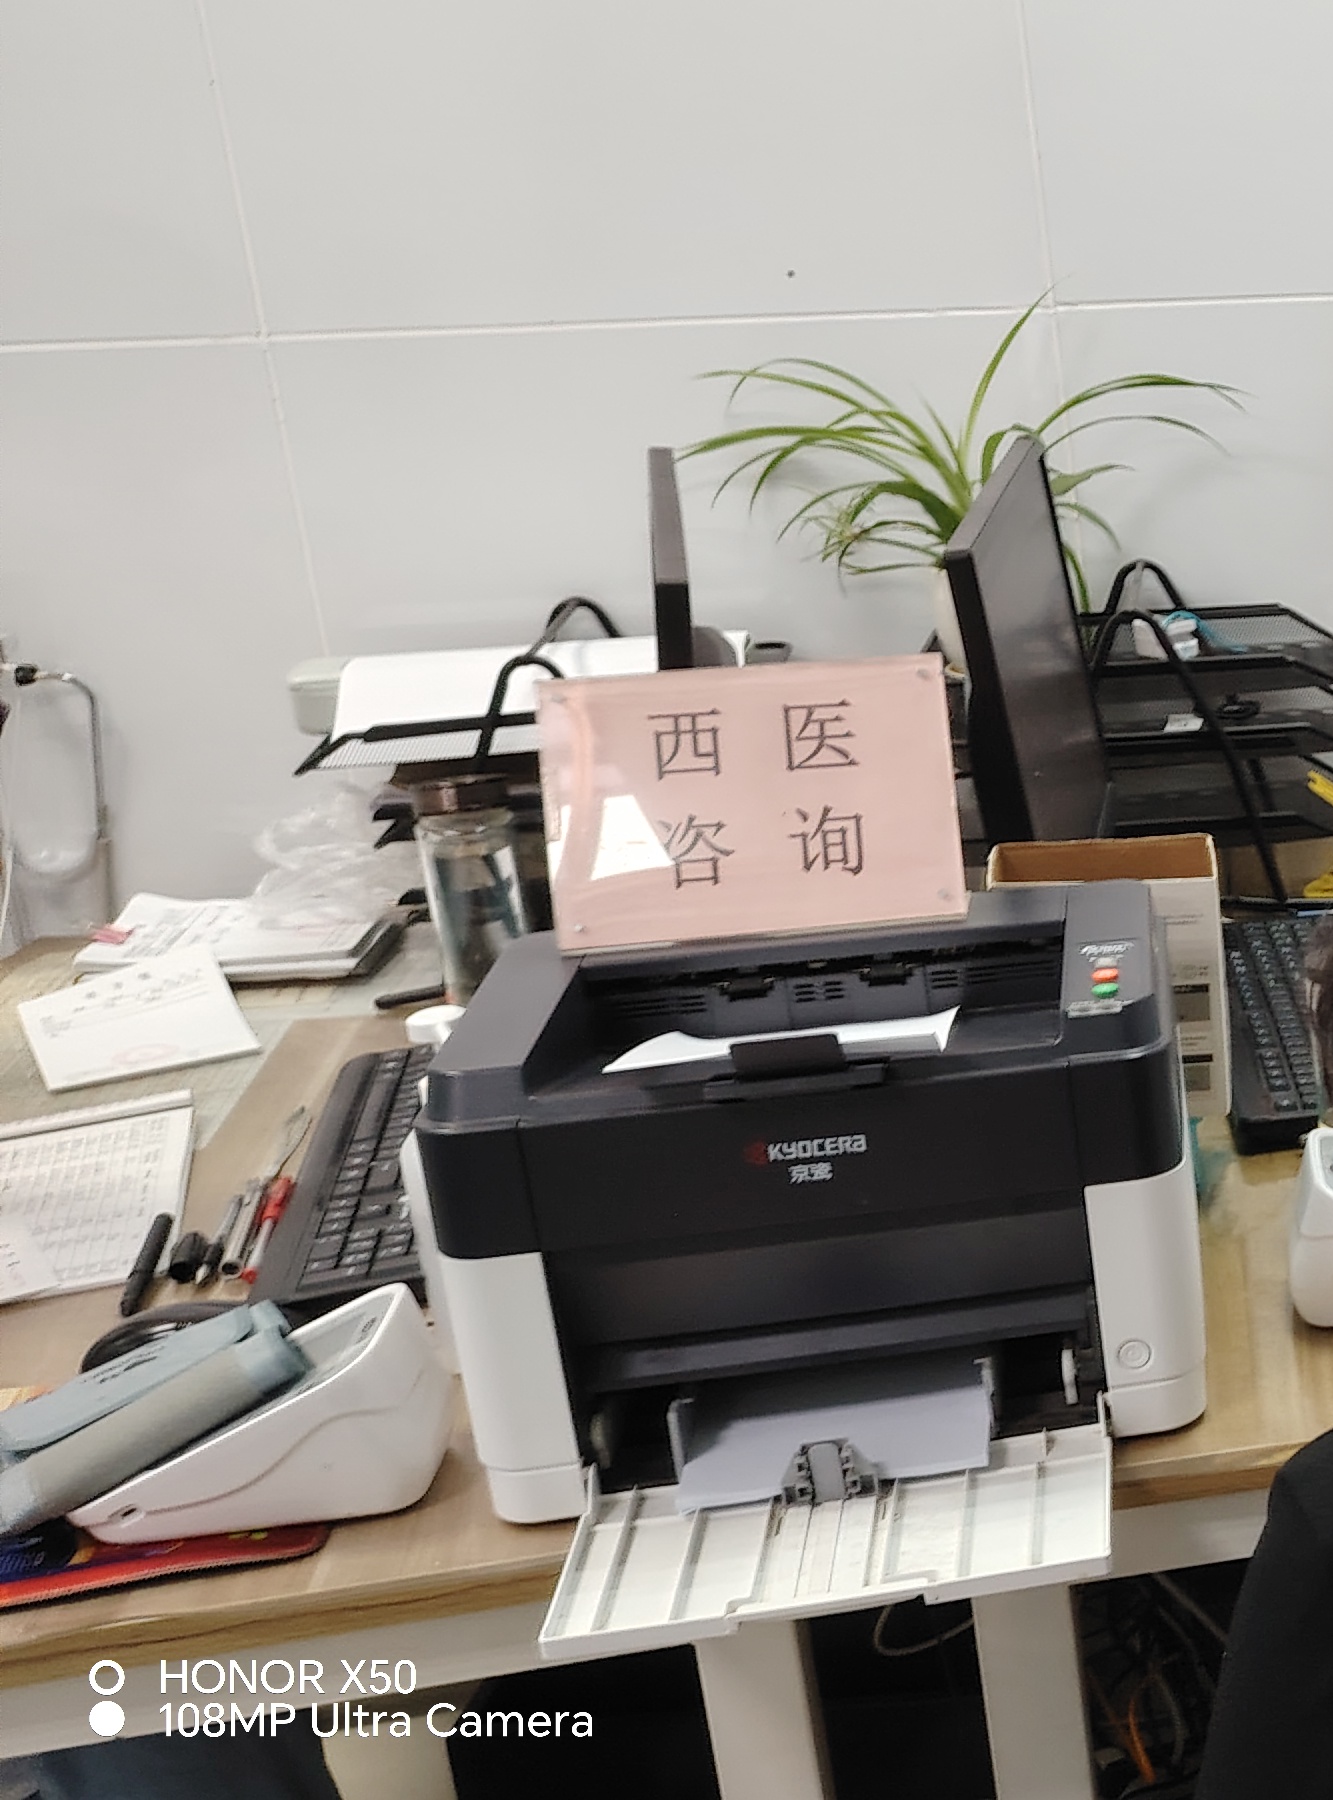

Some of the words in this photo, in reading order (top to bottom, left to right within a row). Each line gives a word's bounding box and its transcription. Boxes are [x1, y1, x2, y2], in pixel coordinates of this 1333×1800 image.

[647, 698, 861, 782] 西医
[656, 804, 864, 890] 咨询
[767, 1134, 868, 1162] KYOCERA
